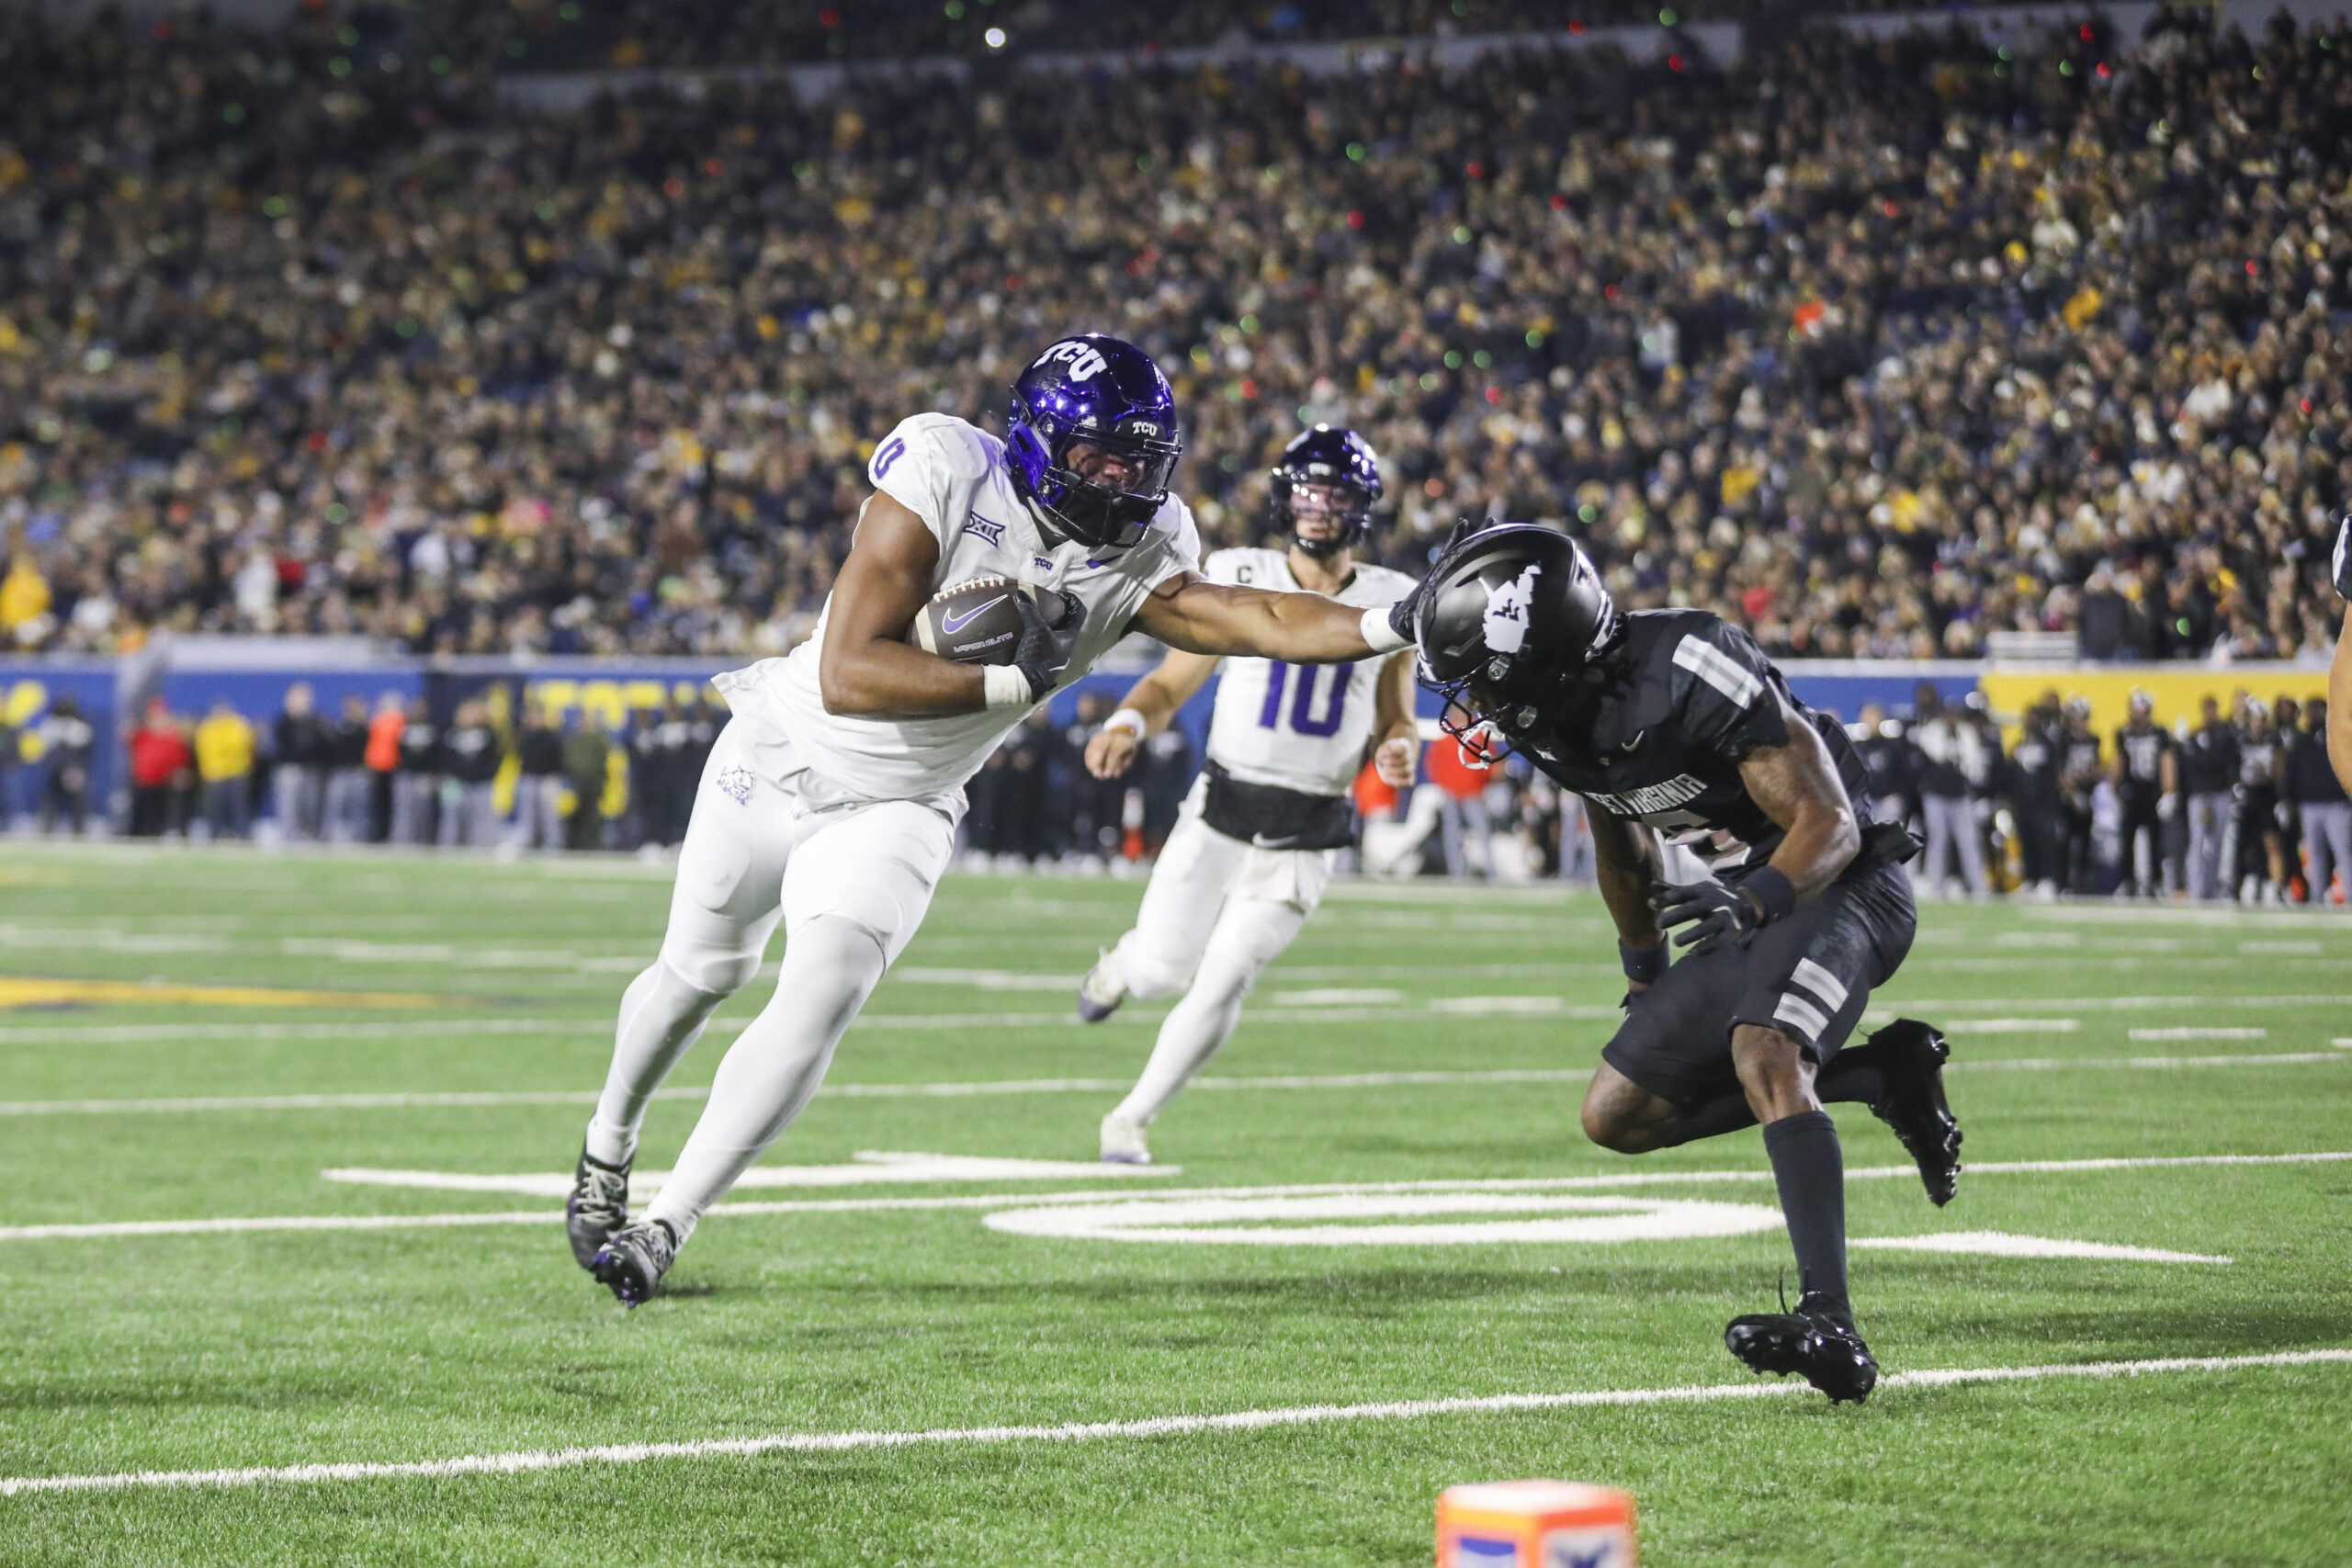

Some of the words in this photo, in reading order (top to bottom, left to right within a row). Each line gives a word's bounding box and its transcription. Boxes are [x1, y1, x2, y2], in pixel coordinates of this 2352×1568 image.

[1032, 341, 1108, 382] TCU
[1132, 421, 1158, 437] TCU
[874, 436, 906, 479] 0
[1034, 557, 1054, 570] TCU
[1238, 565, 1253, 584] C
[1259, 658, 1355, 739] 10
